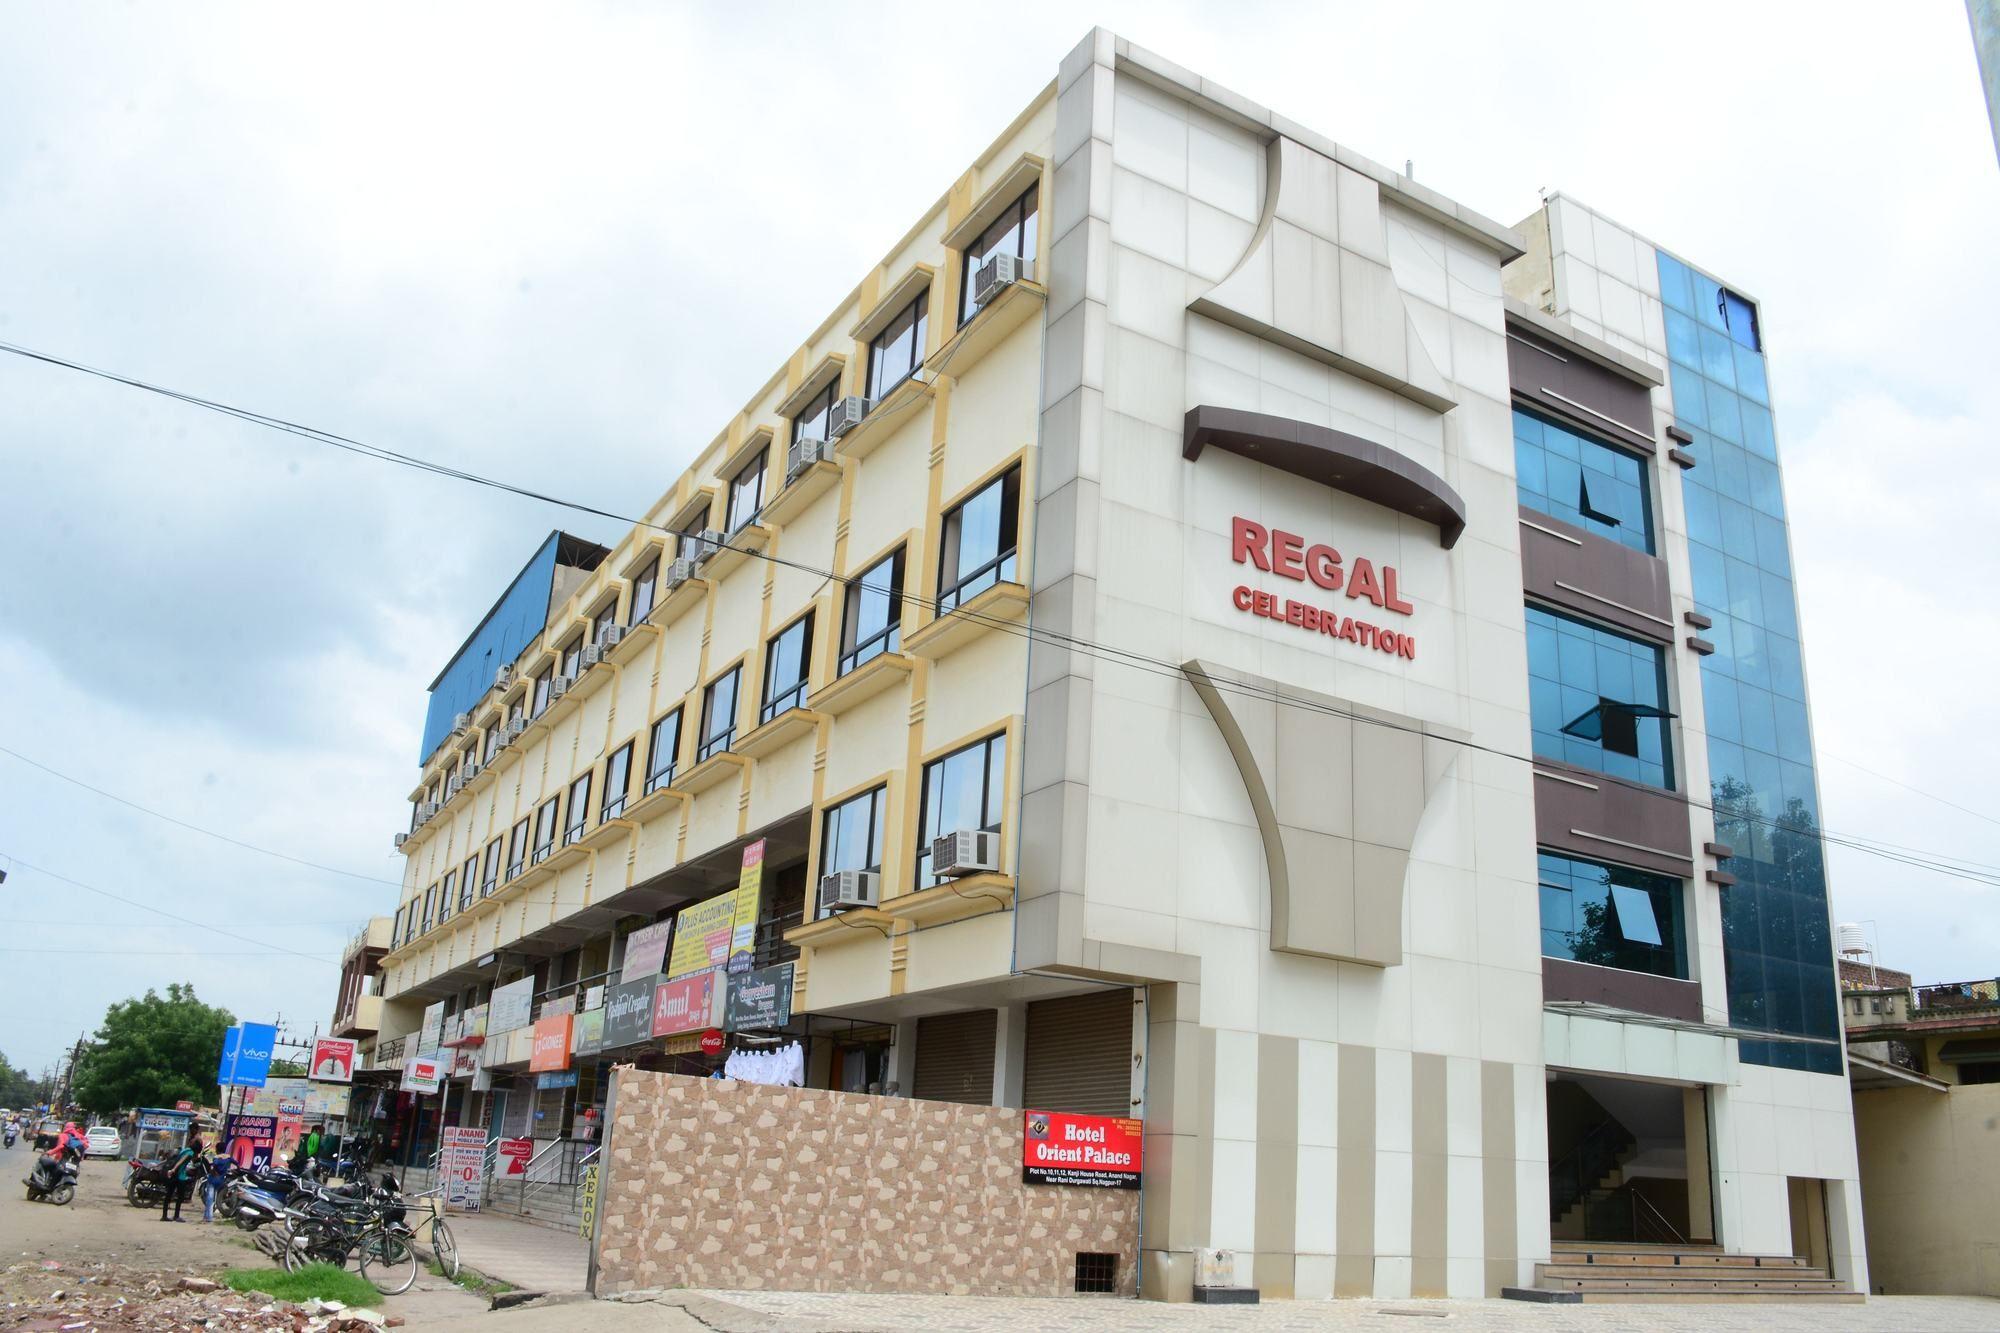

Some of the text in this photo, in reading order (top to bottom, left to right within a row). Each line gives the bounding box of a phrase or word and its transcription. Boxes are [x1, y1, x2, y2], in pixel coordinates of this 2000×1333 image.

[1232, 516, 1413, 615] REGAL
[1233, 586, 1414, 660] CELEBRATION
[657, 985, 690, 1019] Amul
[243, 1047, 269, 1058] vivo
[416, 1069, 433, 1078] Amul
[458, 1129, 486, 1138] ANAND
[1065, 1124, 1105, 1143] Hotel
[1037, 1143, 1131, 1165] Orient Palace
[580, 1166, 598, 1239] XEROX
